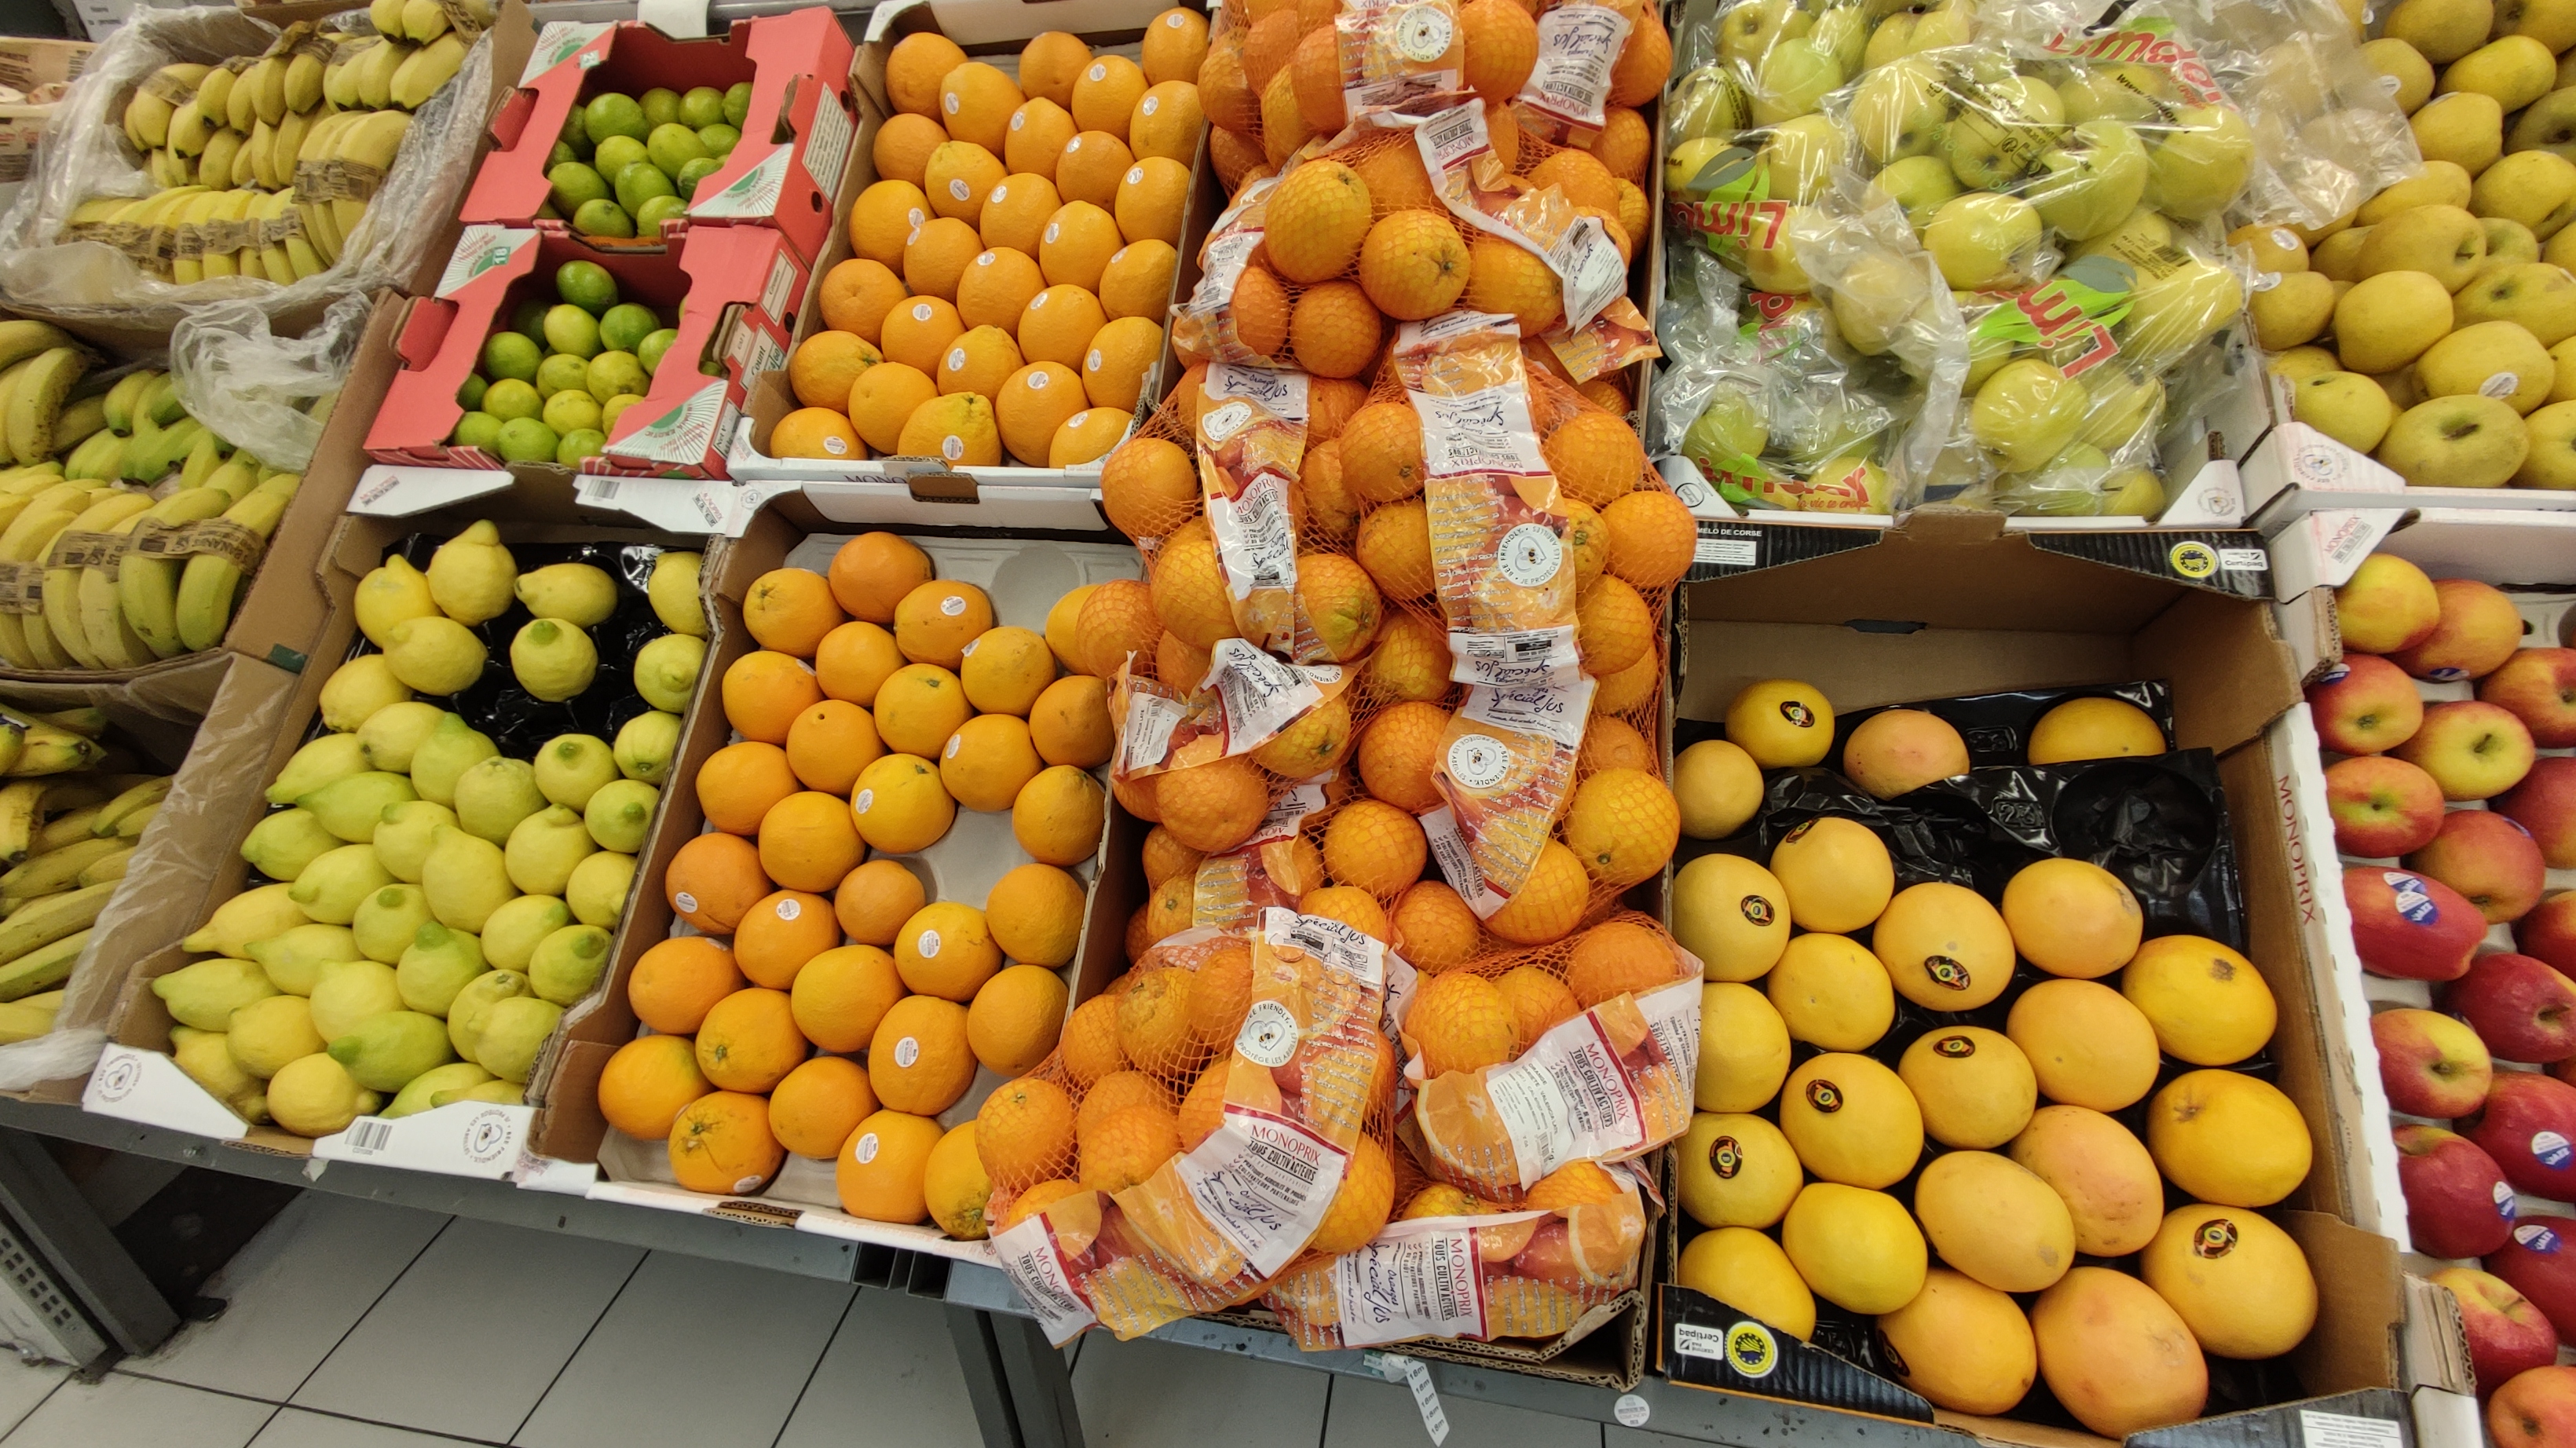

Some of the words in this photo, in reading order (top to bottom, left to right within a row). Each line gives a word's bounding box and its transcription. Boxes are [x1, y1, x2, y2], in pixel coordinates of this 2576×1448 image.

[1537, 91, 1590, 116] MONOPRIX
[1451, 455, 1523, 470] MONOPRIX
[1810, 497, 1824, 508] vie
[1532, 526, 1557, 546] ABEILLES
[1502, 564, 1513, 576] BEE
[1232, 655, 1283, 701] Spécial
[1494, 654, 1550, 681] Spécial
[1490, 686, 1545, 714] Spécial
[1449, 755, 1469, 781] ABEILLES
[1535, 773, 1566, 788] experts
[1440, 840, 1458, 871] CULTIVATEURS
[2278, 775, 2316, 925] MONOPRIX
[2411, 901, 2433, 921] JAZZ
[1293, 911, 1346, 938] Spécial
[1271, 1055, 1283, 1065] LES
[1572, 1048, 1588, 1069] TOUS
[1528, 1060, 1546, 1087] ORANGE
[1580, 1041, 1634, 1123] MONOPRIX
[1536, 1090, 1557, 1121] VALENCIA
[1549, 1120, 1561, 1135] LATE
[1247, 1139, 1268, 1156] TOUS
[1248, 1118, 1324, 1168] MONOPRIX
[2545, 1146, 2571, 1167] JAZZ
[1235, 1164, 1272, 1190] CULTIVATEURS
[1269, 1187, 1300, 1206] PARTENAIRES
[1240, 1159, 1266, 1179] PRATIQUES
[1264, 1176, 1286, 1190] AGRICOLES
[1434, 1239, 1445, 1260] TOUS
[2536, 1230, 2555, 1249] JAZZ
[1019, 1253, 1037, 1274] TOUS
[1366, 1241, 1392, 1304] Spécial
[1409, 1251, 1419, 1287] CULTIVATEURS
[1381, 1269, 1398, 1306] Oranges
[1450, 1238, 1473, 1318] MONOPRIX
[1678, 1326, 1719, 1344] Certipaq
[1407, 1365, 1426, 1380] 18m
[1413, 1378, 1432, 1394] 18m
[1418, 1392, 1436, 1408] 18m
[1423, 1405, 1441, 1421] 18m
[1429, 1419, 1447, 1435] 18m
